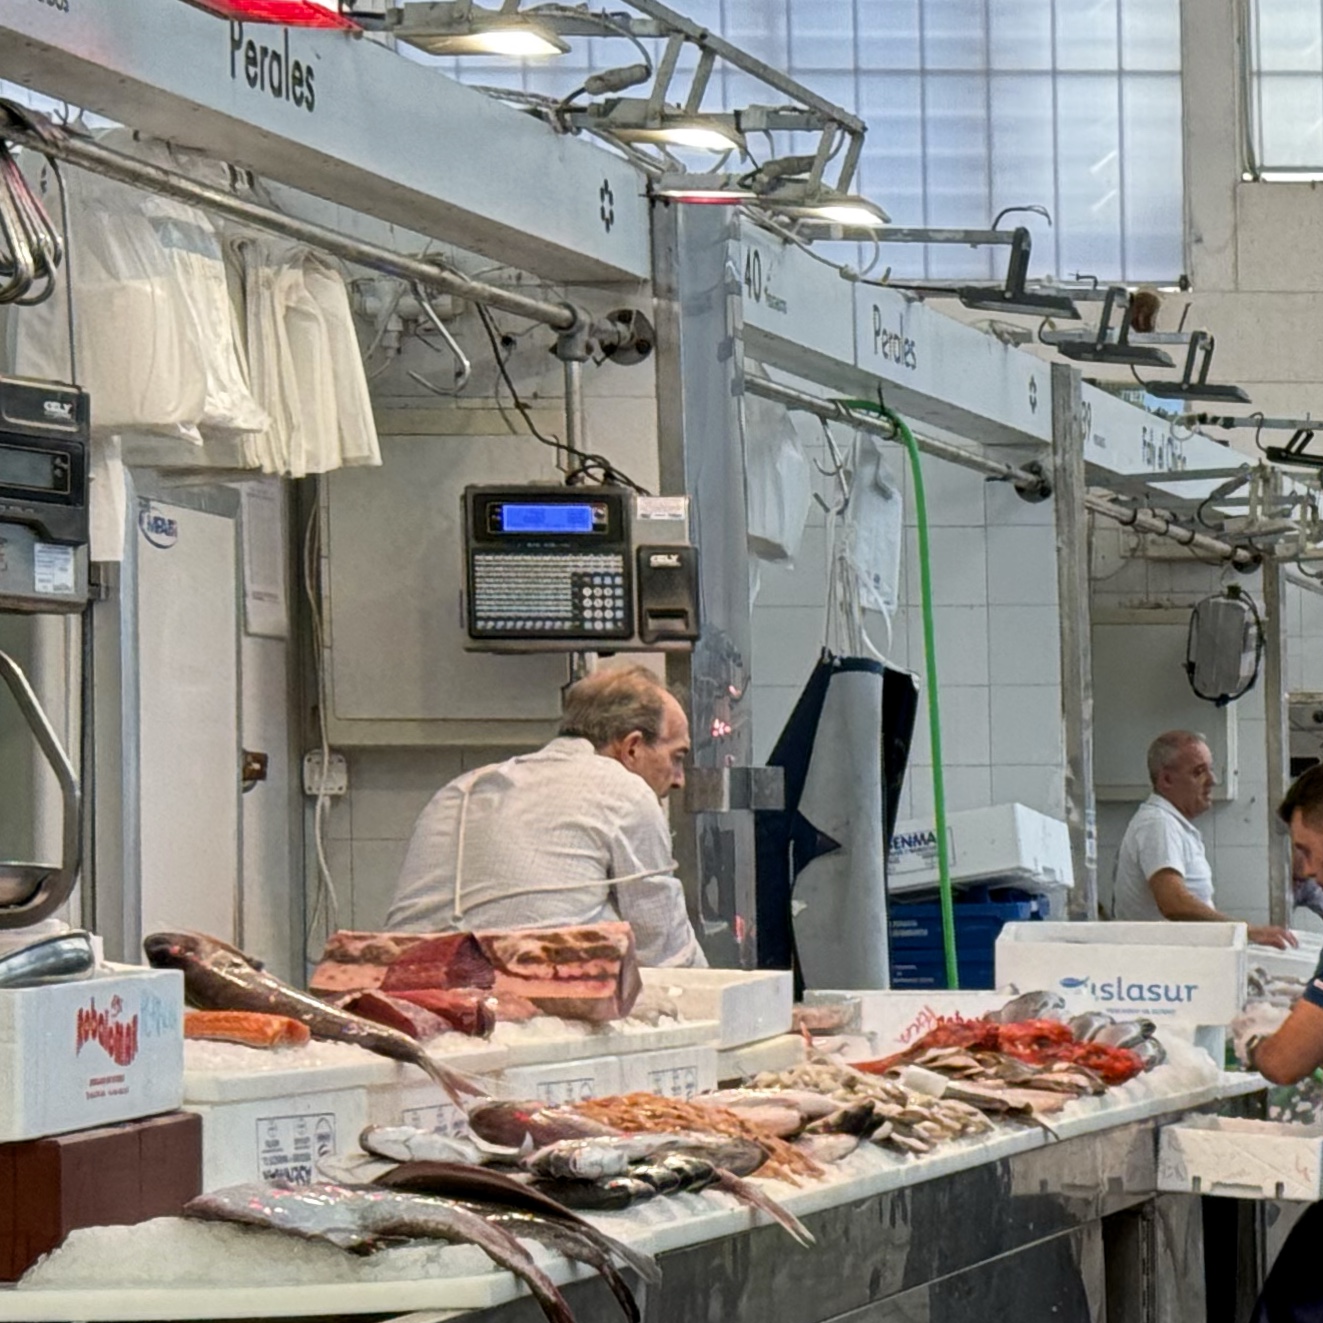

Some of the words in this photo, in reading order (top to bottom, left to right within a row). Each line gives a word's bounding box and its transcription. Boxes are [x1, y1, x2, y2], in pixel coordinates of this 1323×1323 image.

[229, 19, 315, 112] Perales
[744, 247, 762, 303] 40
[872, 303, 917, 370] Perales
[1090, 975, 1199, 1003] islasur
